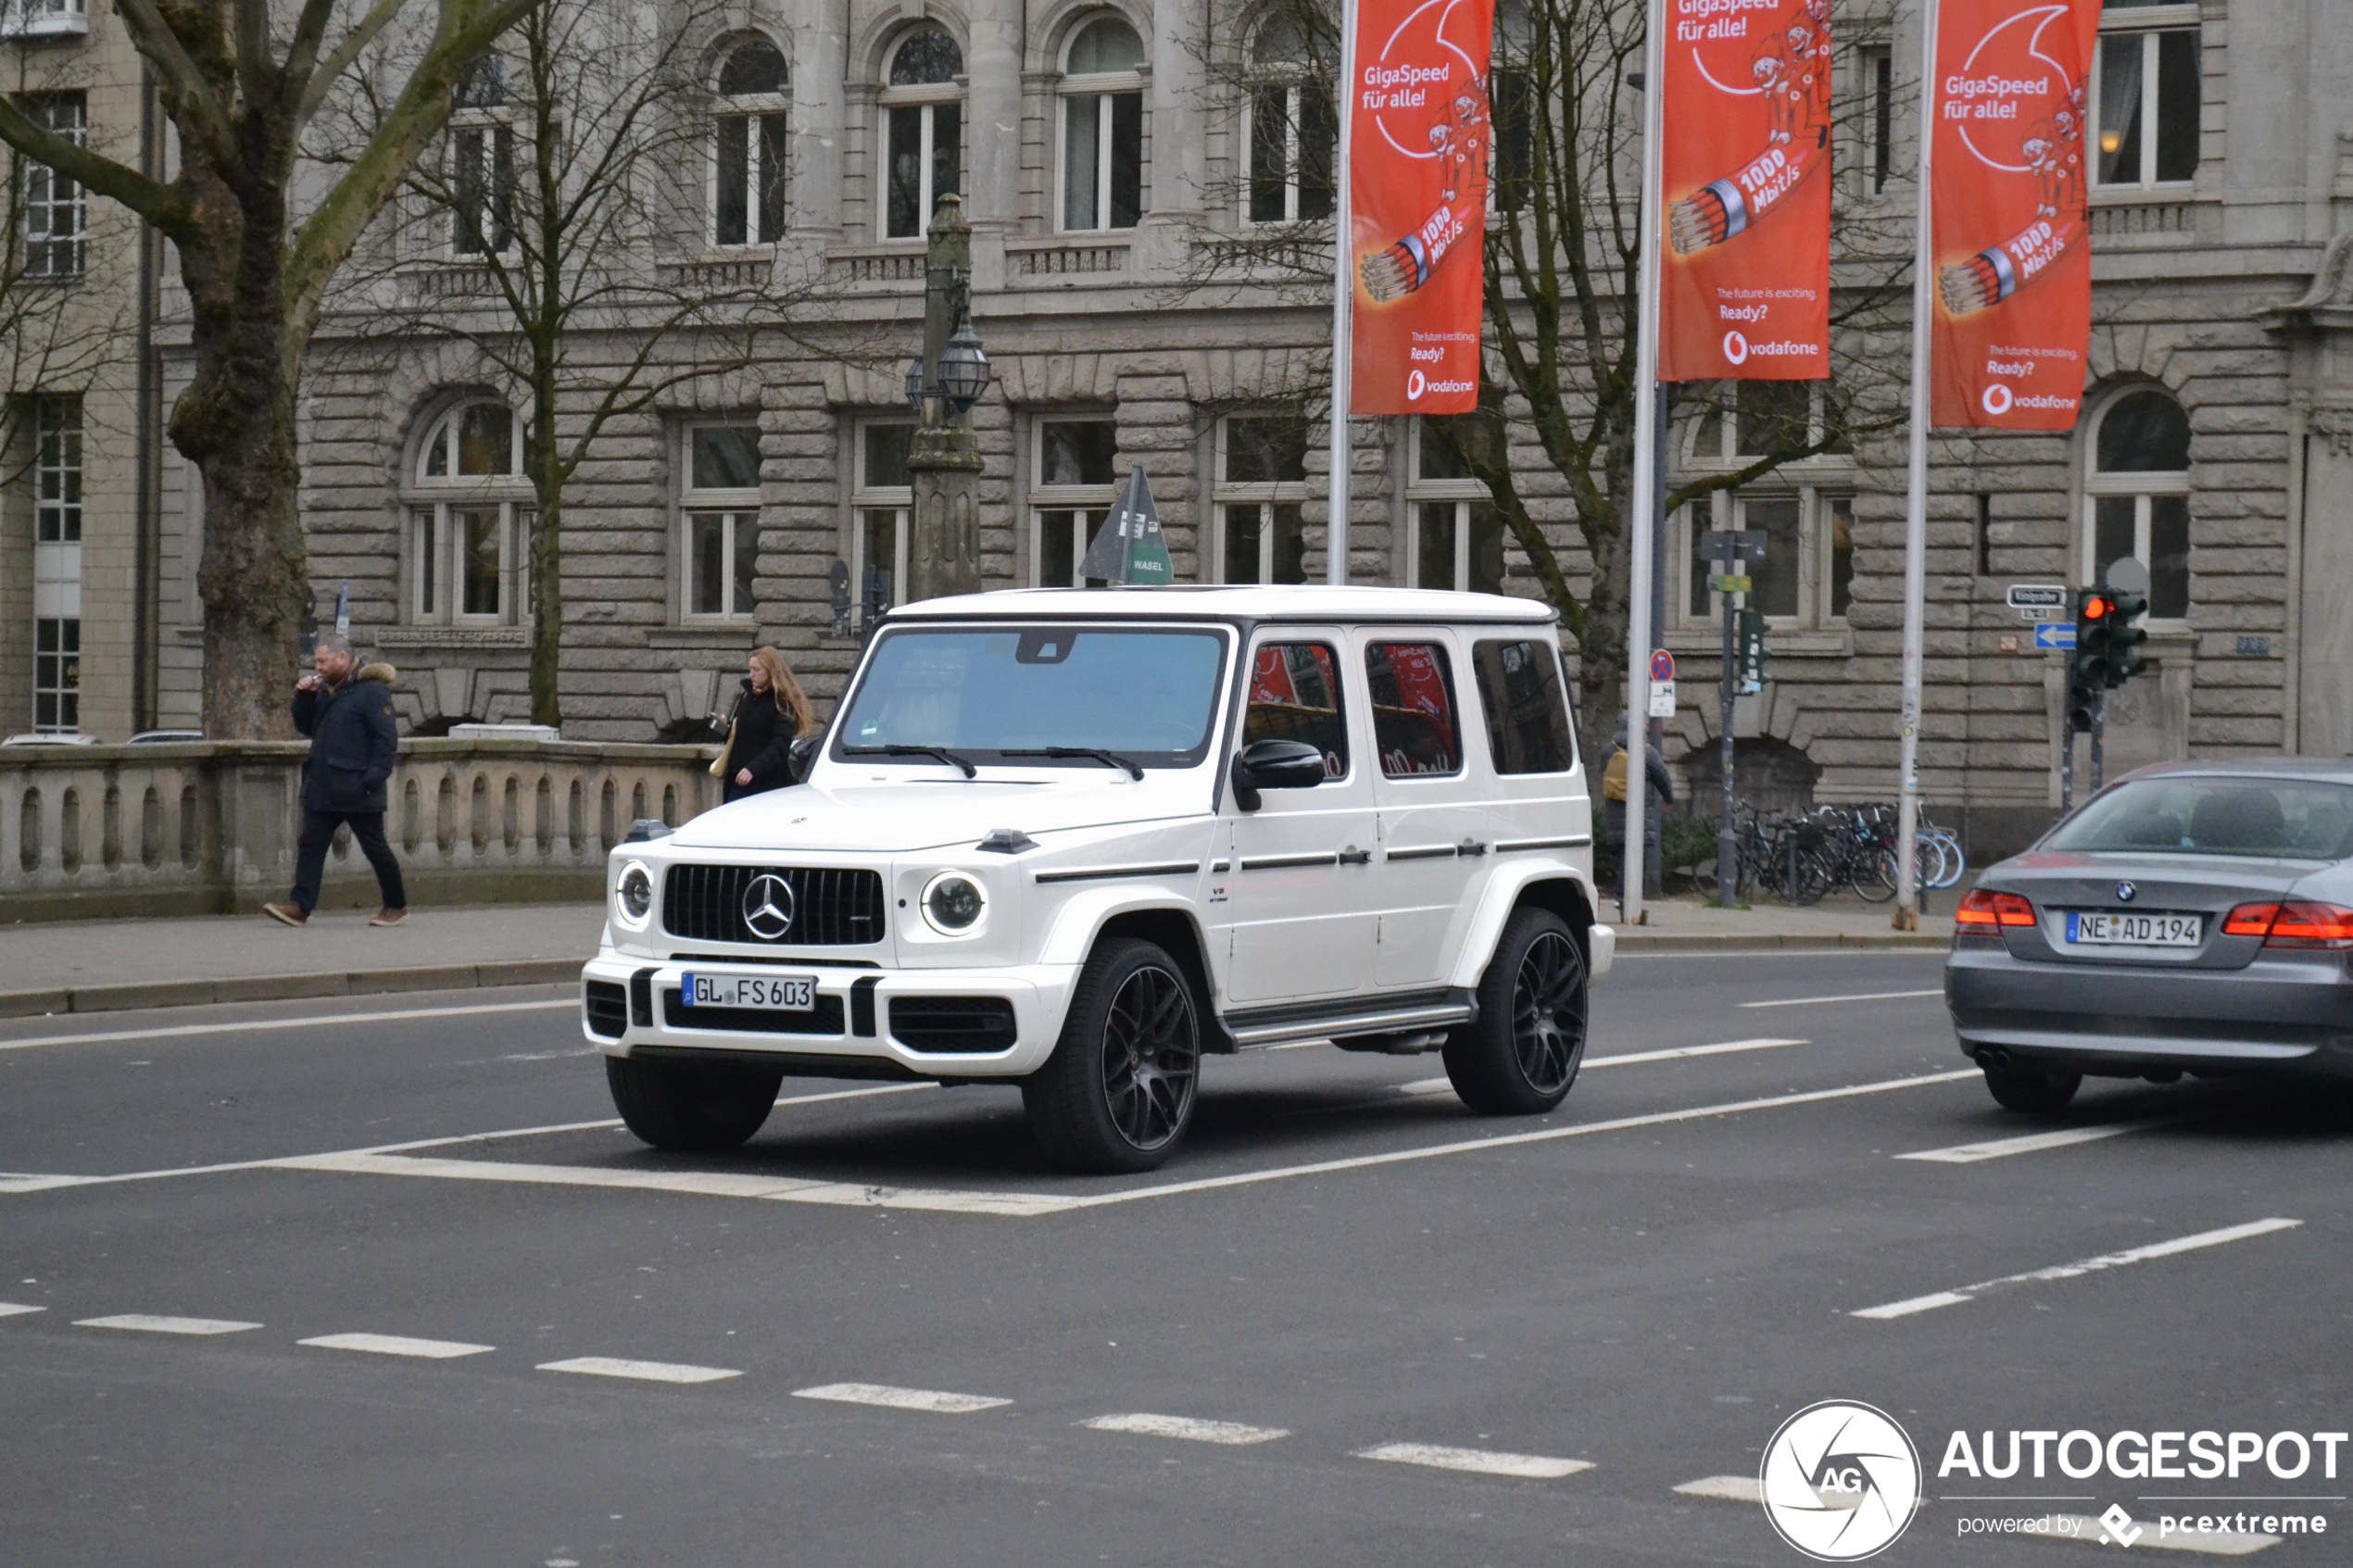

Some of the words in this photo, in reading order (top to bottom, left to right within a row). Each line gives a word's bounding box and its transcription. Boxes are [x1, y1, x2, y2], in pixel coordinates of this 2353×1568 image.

[1678, 20, 1705, 41] für
[1707, 17, 1747, 38] alle!
[1365, 63, 1450, 88] GigaSpeed
[1945, 75, 2048, 98] GigaSpeed
[1363, 91, 1387, 109] für
[1390, 88, 1426, 107] alle!
[1944, 100, 1971, 119] für
[1974, 100, 2017, 119] alle!
[1741, 148, 1785, 193] 1000
[1753, 165, 1800, 214] Mbit/s
[1422, 206, 1452, 246] 1000
[1430, 220, 1464, 265] Mbit/s
[2010, 221, 2052, 260] 1000
[2021, 236, 2065, 279] Mbit/s
[1717, 287, 1733, 298] The
[1734, 287, 1764, 298] future
[1766, 287, 1774, 297] is
[1719, 304, 1768, 323] Ready?
[1411, 332, 1424, 342] The
[1425, 332, 1441, 342] future
[1411, 346, 1444, 363] Ready?
[1748, 340, 1818, 356] vodafone
[1989, 345, 2004, 355] The
[2004, 345, 2032, 357] future
[2032, 346, 2041, 357] is
[1987, 359, 2034, 378] Ready?
[1427, 379, 1474, 393] vodafone
[2014, 394, 2077, 409] vodafone
[1134, 560, 1164, 571] WASEL
[2079, 917, 2108, 939] NE
[2122, 918, 2152, 941] AD
[2155, 919, 2197, 942] 194
[696, 978, 723, 1003] GL
[737, 980, 765, 1005] FS
[770, 981, 811, 1006] 603
